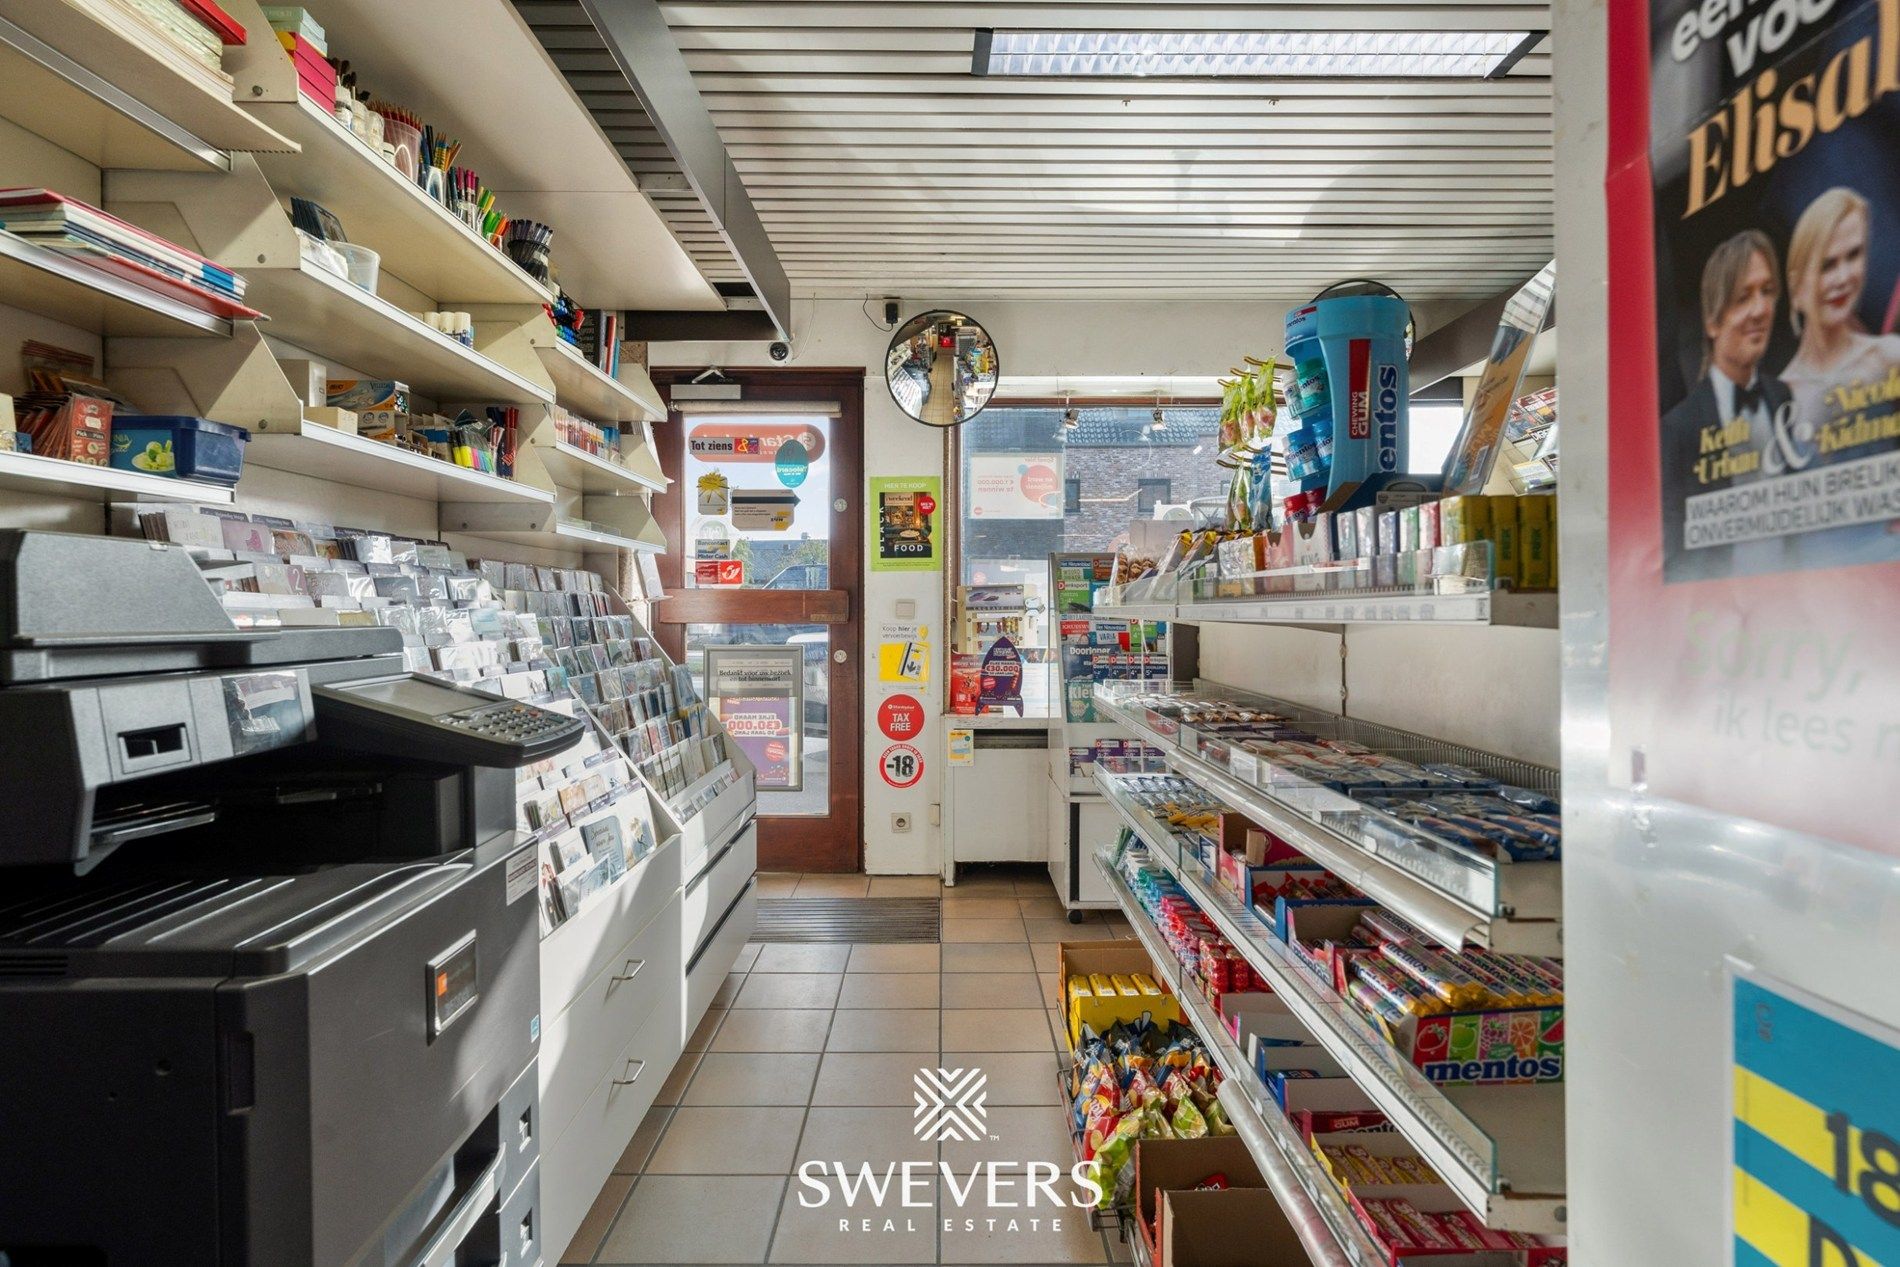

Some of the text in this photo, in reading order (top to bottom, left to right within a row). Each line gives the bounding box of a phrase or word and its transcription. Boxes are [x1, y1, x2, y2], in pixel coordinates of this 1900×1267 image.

[1358, 391, 1368, 435] GUM
[1374, 366, 1397, 472] entos
[690, 440, 706, 451] Tot
[708, 440, 733, 451] ziens
[1762, 400, 1813, 475] &
[1689, 490, 1768, 521] WAAROM
[1772, 478, 1820, 506] HUN
[893, 544, 924, 552] FOOD
[1681, 611, 1866, 703] Sorry,
[890, 722, 912, 732] FREE
[891, 713, 910, 723] TAX
[1761, 697, 1855, 753] lees
[886, 754, 914, 777] -18
[1386, 942, 1429, 973] mentos
[1424, 1054, 1562, 1082] mentos
